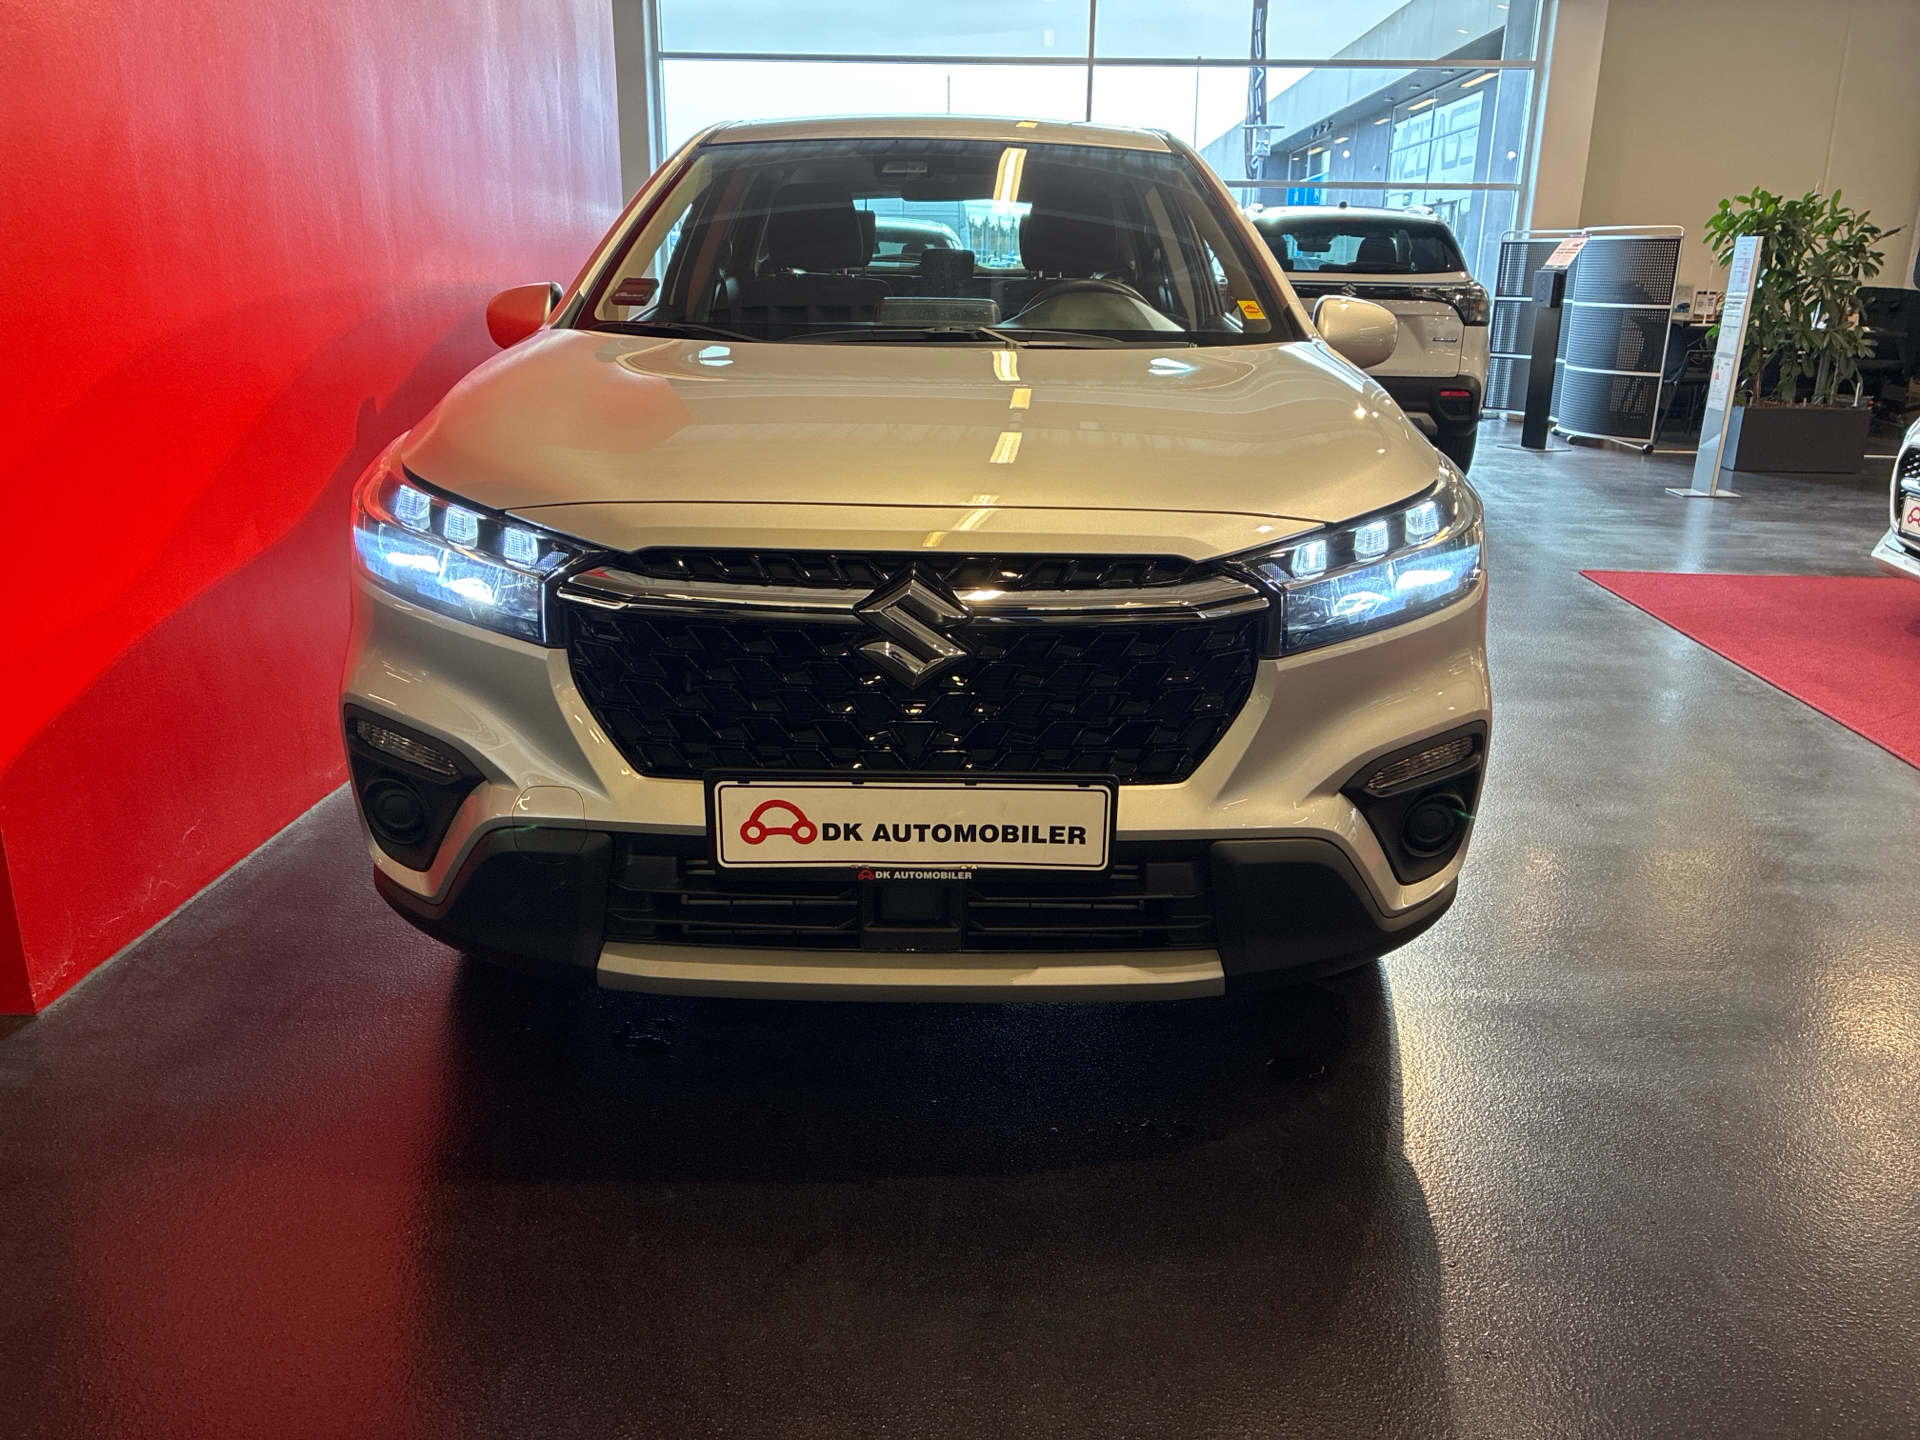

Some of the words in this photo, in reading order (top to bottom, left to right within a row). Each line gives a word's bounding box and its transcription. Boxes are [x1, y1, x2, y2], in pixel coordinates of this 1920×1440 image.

[822, 823, 863, 841] DK
[871, 824, 1086, 845] AUTOMOBILER
[875, 871, 891, 879] DK
[893, 871, 972, 879] AUTOMOBILER
